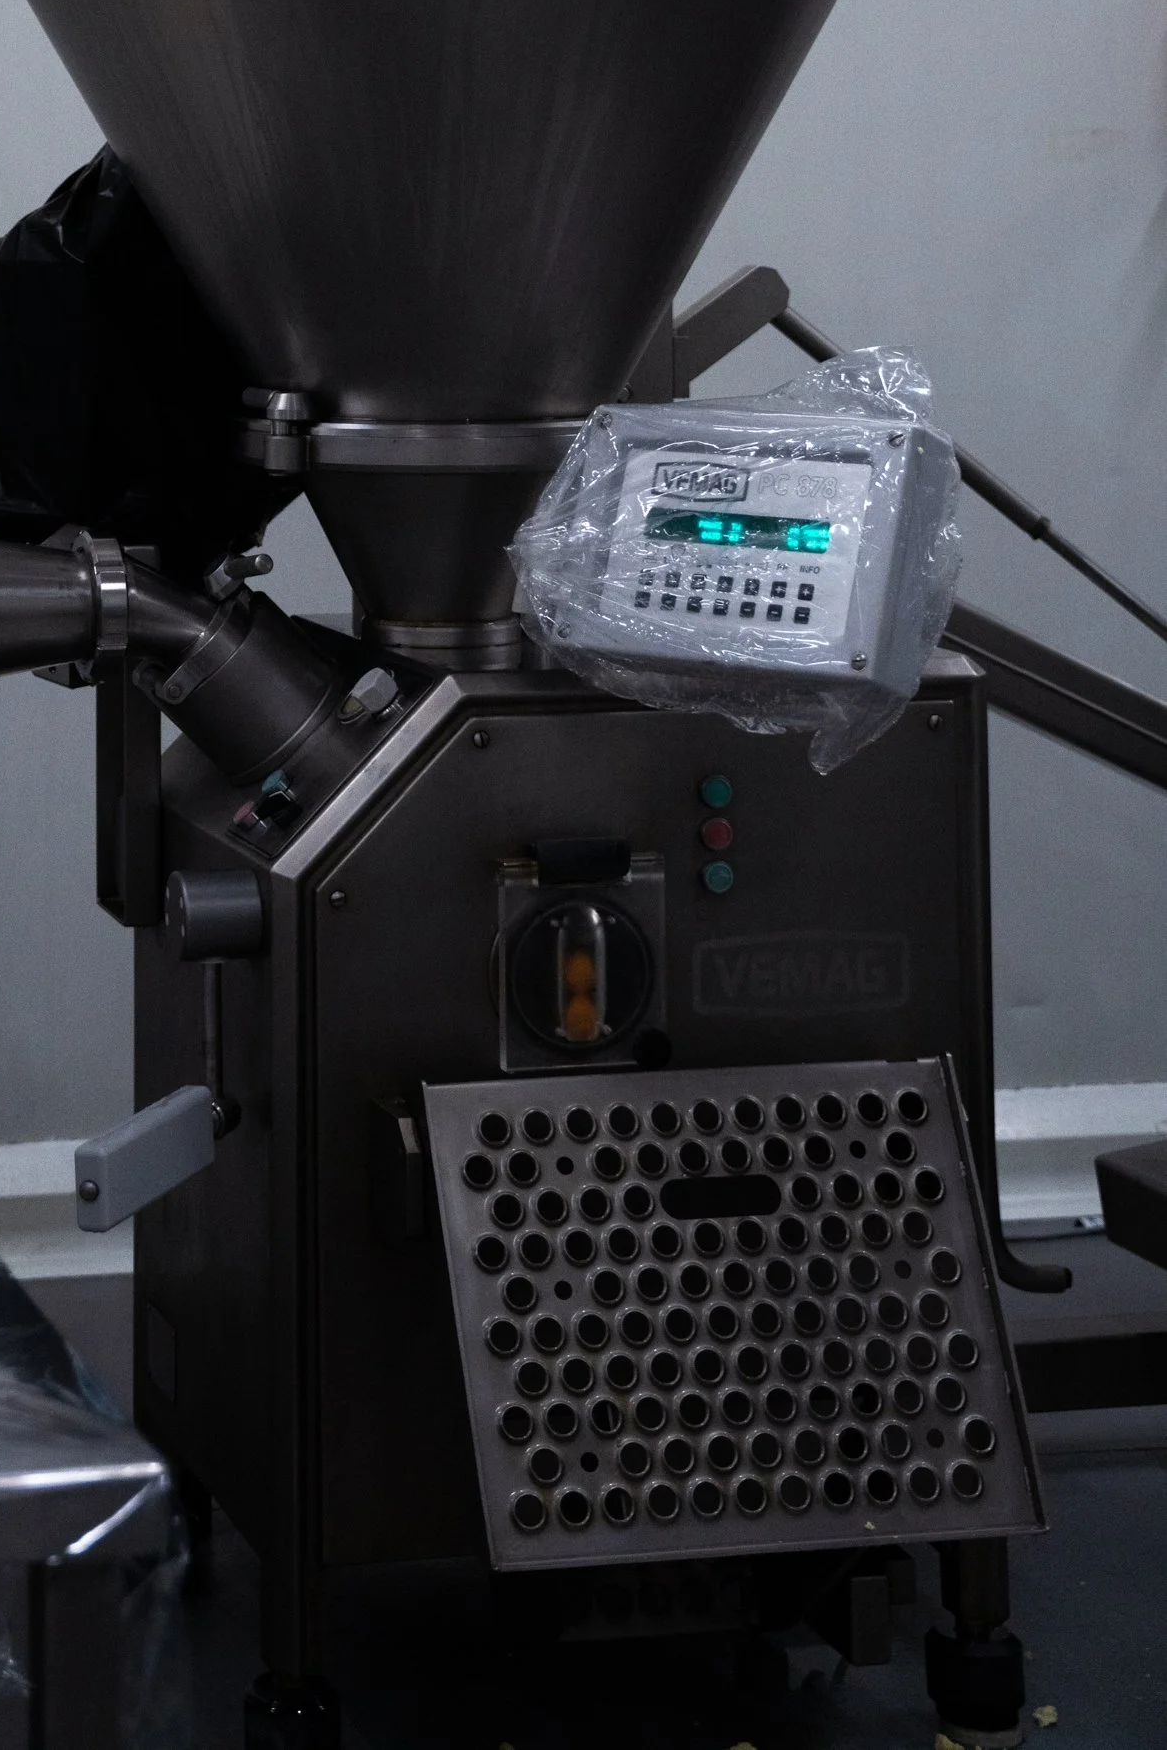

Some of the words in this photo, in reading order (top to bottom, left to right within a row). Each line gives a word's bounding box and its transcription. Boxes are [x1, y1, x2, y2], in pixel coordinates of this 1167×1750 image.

[662, 468, 738, 495] VEMAG
[758, 472, 791, 496] PC
[797, 474, 838, 499] 878
[799, 564, 821, 575] INFO
[714, 949, 887, 998] VEMAG
